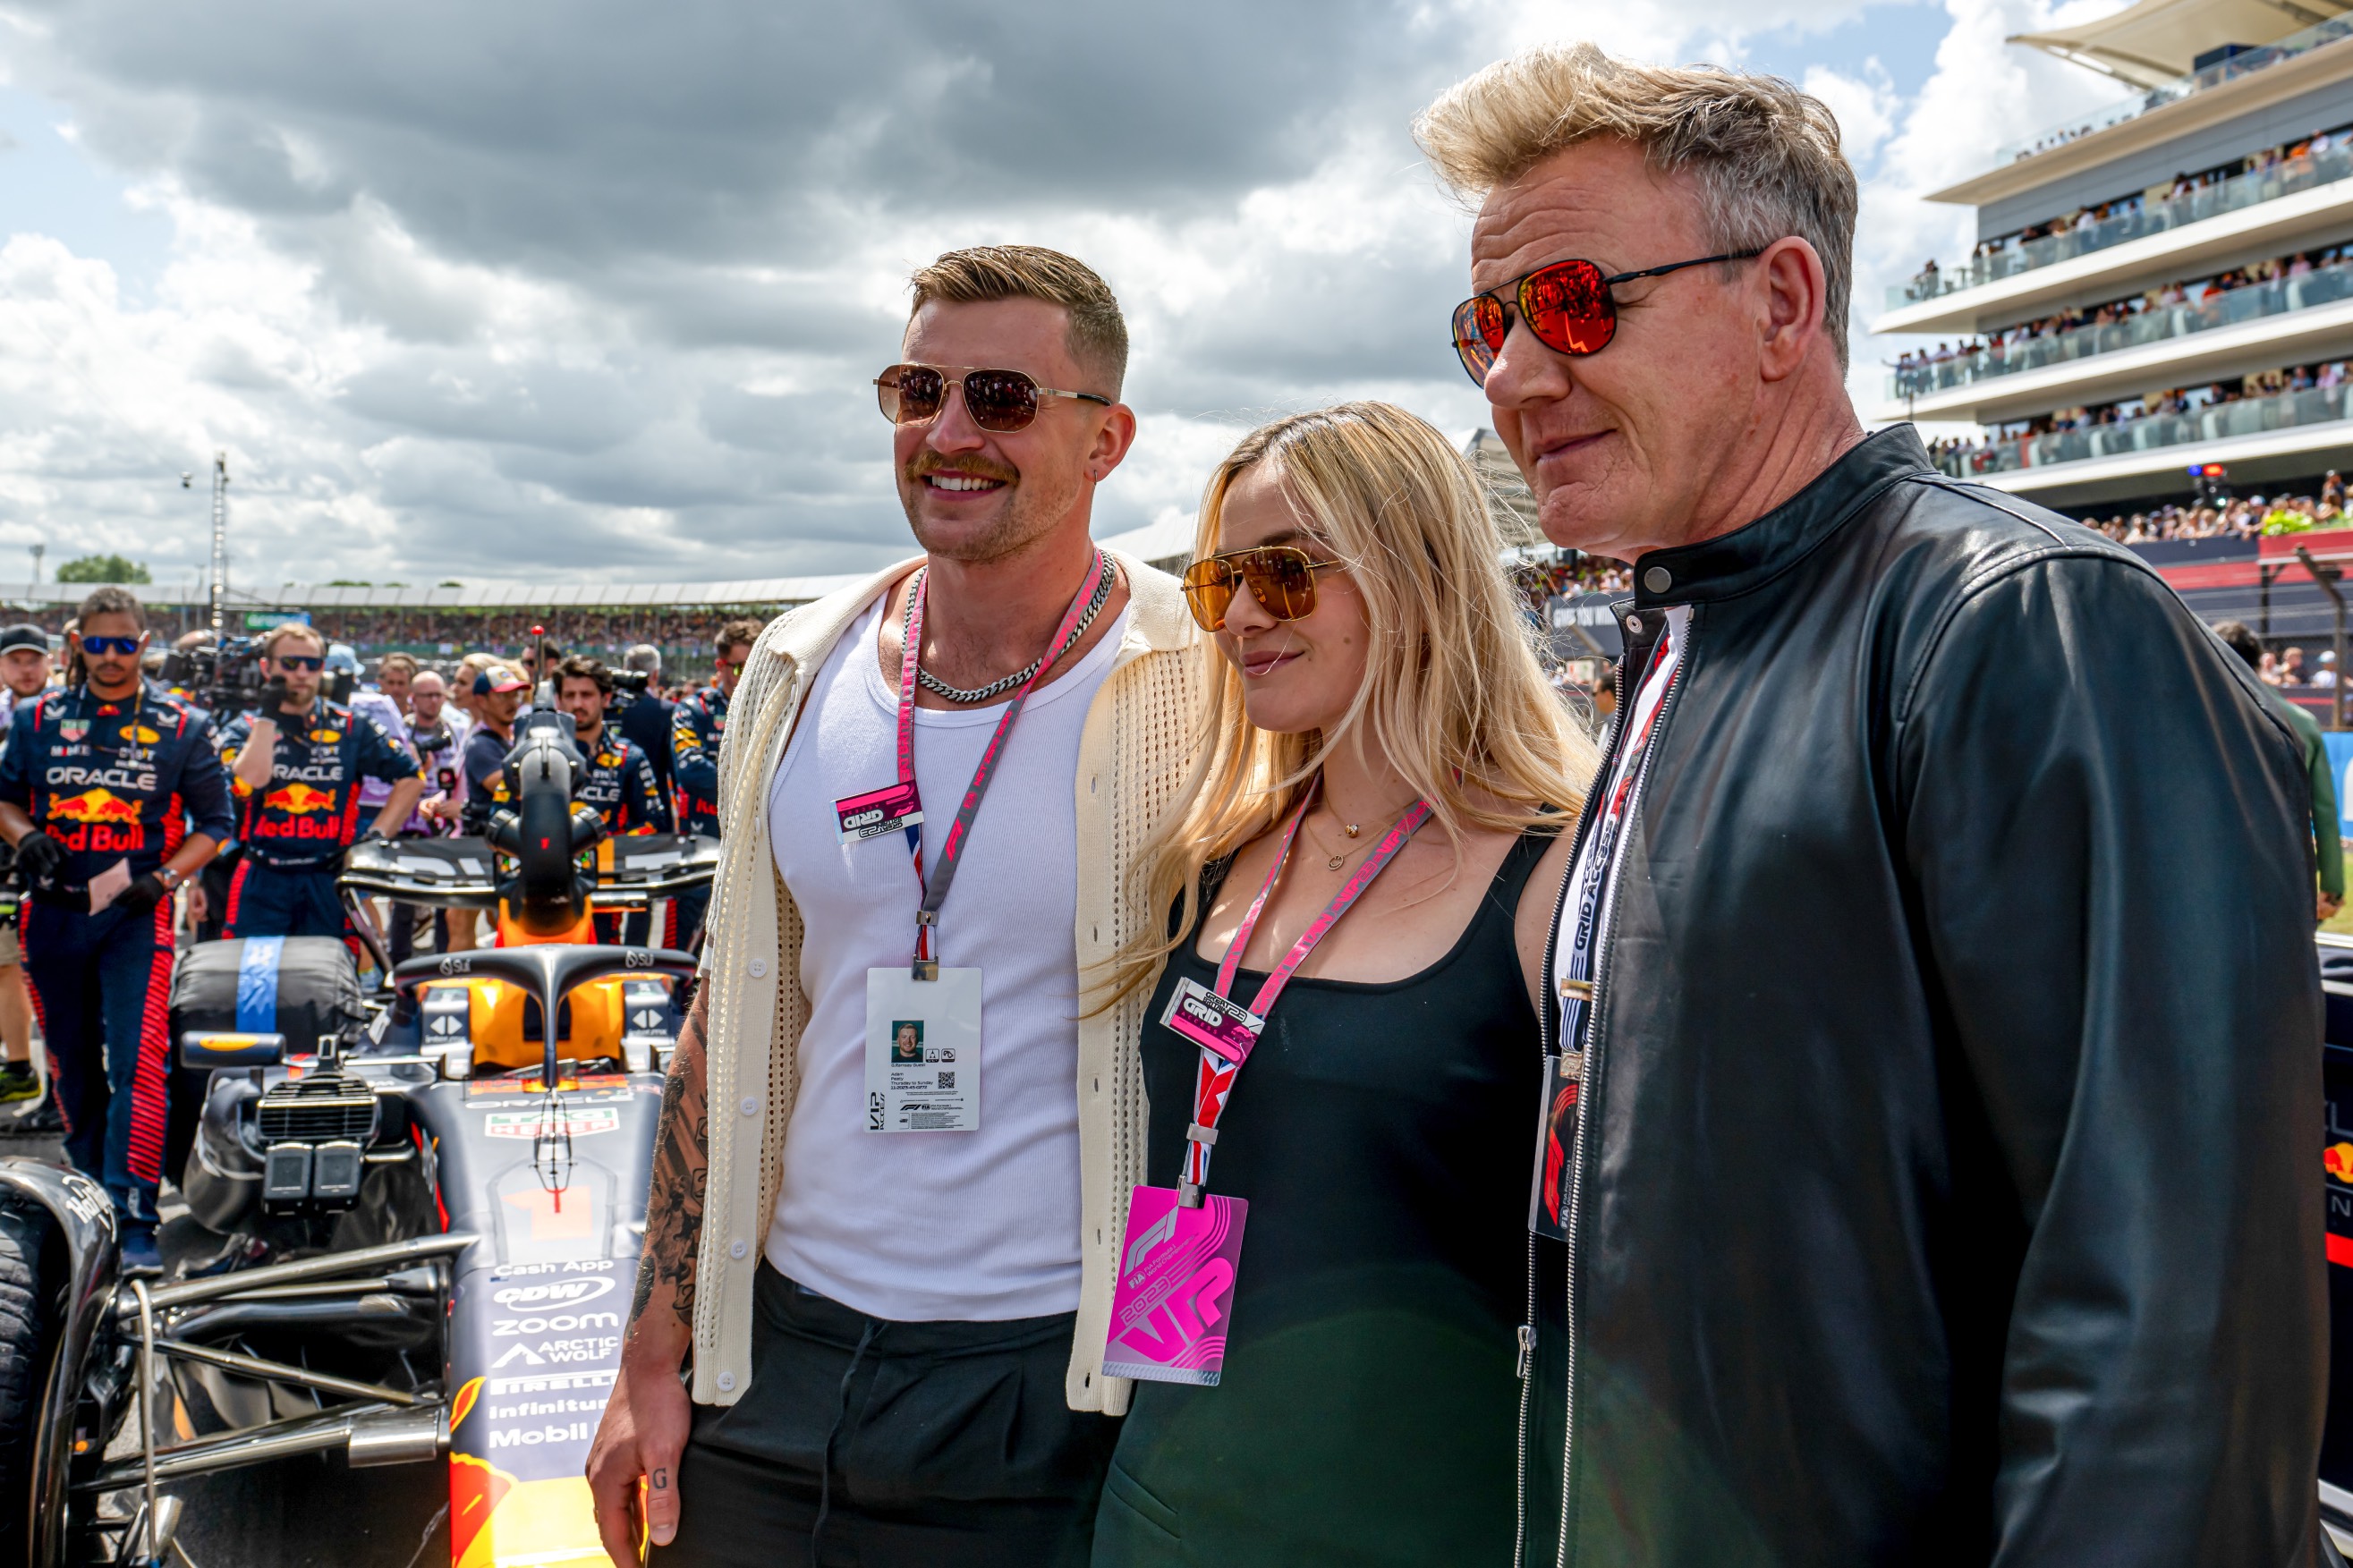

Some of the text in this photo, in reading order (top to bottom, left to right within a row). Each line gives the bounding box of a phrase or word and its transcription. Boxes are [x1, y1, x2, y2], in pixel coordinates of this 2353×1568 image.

[973, 764, 988, 786] NET
[996, 710, 1013, 736] 2030
[47, 767, 157, 792] ORACLE
[272, 763, 344, 781] RACLE
[297, 816, 340, 839] Bull
[843, 809, 884, 829] GRID
[90, 822, 145, 852] Bull
[1575, 818, 1615, 951] GRID ACCESS
[1181, 1011, 1218, 1035] ACCESS
[1183, 997, 1223, 1027] GRID
[1227, 1005, 1248, 1023] 23
[870, 1091, 879, 1130] VIP
[1561, 1208, 1570, 1229] FIA
[494, 1259, 615, 1276] Cash App
[1144, 1262, 1153, 1273] FIA
[1152, 1244, 1174, 1265] Formula
[1147, 1261, 1163, 1277] World
[1128, 1274, 1146, 1290] FIA
[493, 1284, 590, 1304] CDW
[1119, 1275, 1172, 1326] 2023
[1118, 1257, 1234, 1363] VIP
[493, 1312, 619, 1336] zoom
[539, 1336, 619, 1352] ARCTIC
[548, 1348, 612, 1363] WOLF
[488, 1422, 588, 1448] Mobil
[652, 1468, 667, 1488] G
